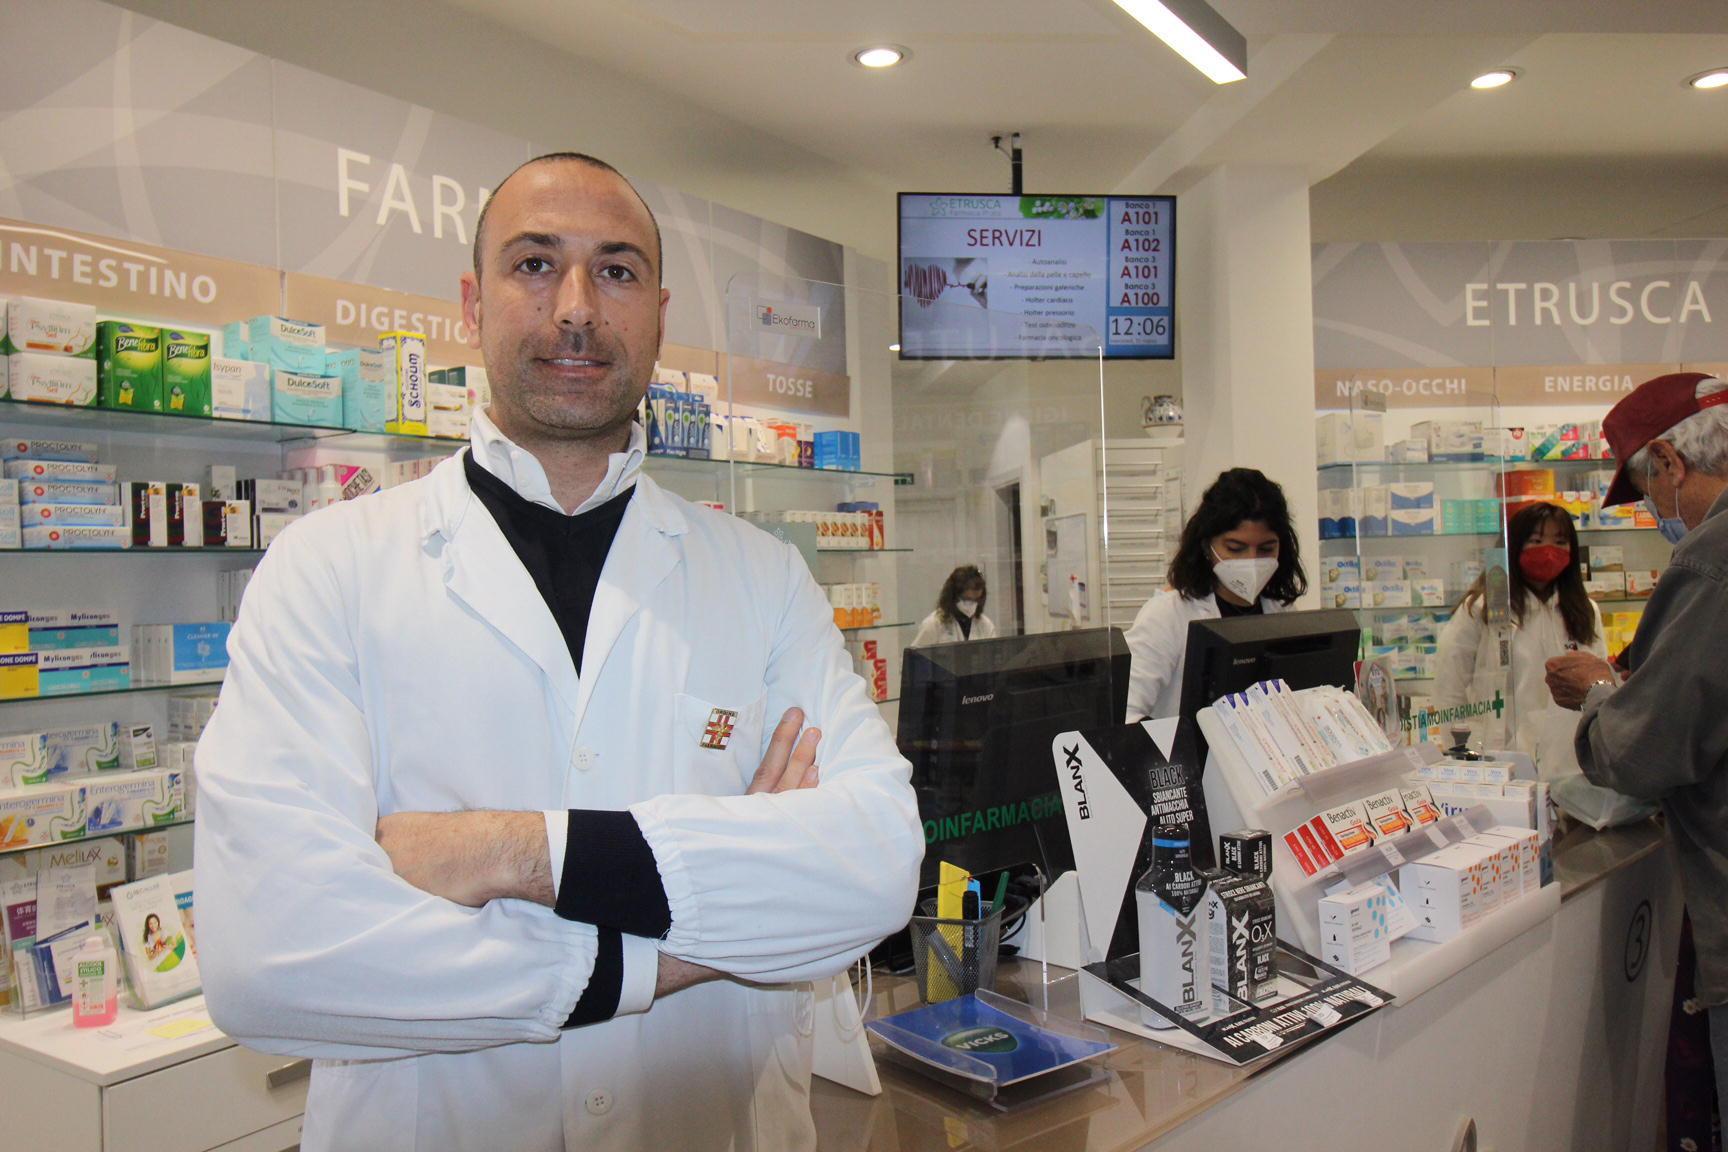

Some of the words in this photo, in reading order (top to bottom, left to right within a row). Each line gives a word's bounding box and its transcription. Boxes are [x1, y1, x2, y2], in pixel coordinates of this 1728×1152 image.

[337, 147, 491, 245] FAR
[949, 198, 1001, 209] ETRUSCA
[1125, 201, 1150, 209] Banco
[1120, 211, 1159, 225] A101
[967, 228, 1042, 247] SERVIZI
[1120, 238, 1161, 252] A102
[1120, 265, 1158, 279] A101
[1120, 292, 1160, 306] A100
[1465, 280, 1711, 326] ETRUSCA
[772, 313, 815, 329] Ekofarma
[1111, 317, 1166, 336] 12:06
[408, 352, 420, 409] SCHOUM
[766, 374, 813, 398] TOSSE
[1336, 378, 1467, 397] NASO-OCCHI
[1544, 375, 1634, 392] ENERGIA
[962, 693, 994, 705] lenovo
[1062, 743, 1090, 820] BLANX
[1149, 764, 1185, 790] BLACK
[0, 794, 65, 811] nterogermina
[1151, 798, 1189, 816] ANTIMACCHIA
[1367, 794, 1393, 810] Benactiv
[1175, 809, 1194, 824] SUPER
[1326, 806, 1356, 824] Benactiv
[1174, 870, 1195, 882] BLACK
[1631, 914, 1645, 970] 3
[1175, 914, 1197, 1004] BLANX
[1231, 909, 1250, 1001] BLANX
[1257, 953, 1270, 965] BLACK
[955, 1031, 1010, 1051] VICKS
